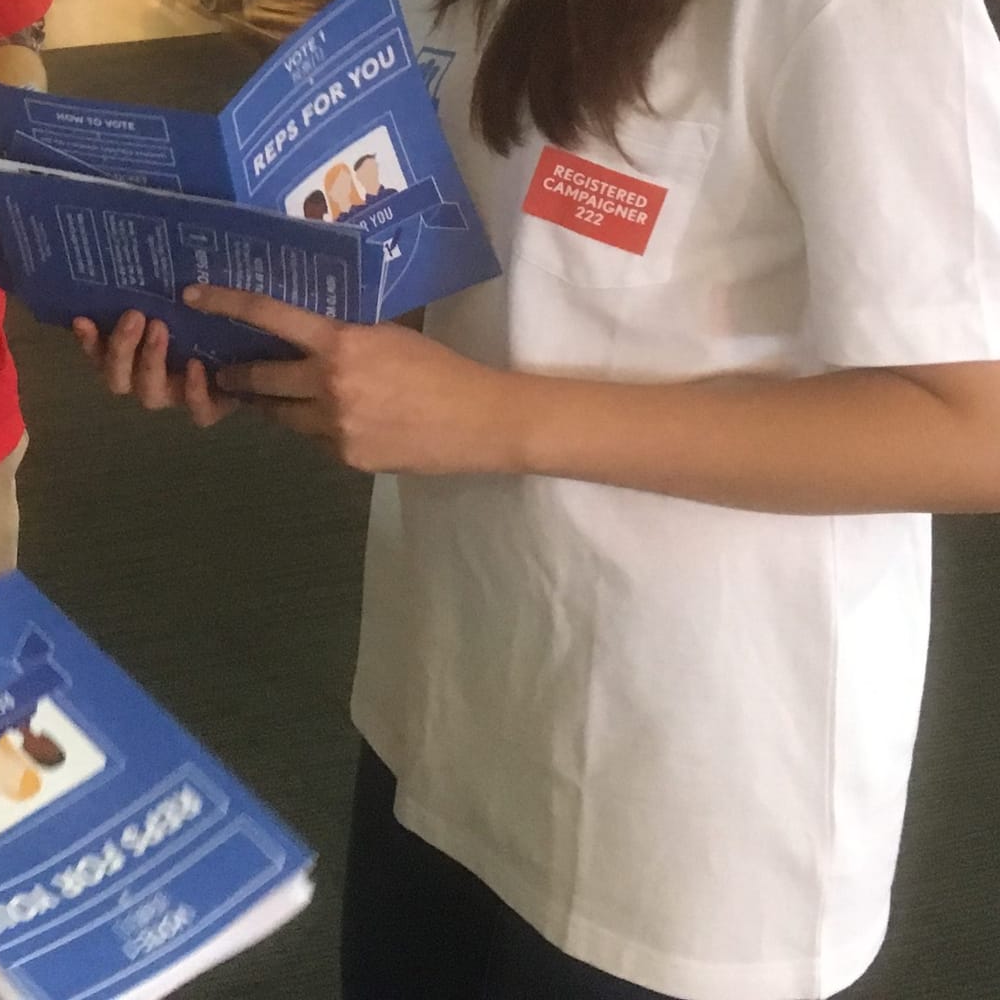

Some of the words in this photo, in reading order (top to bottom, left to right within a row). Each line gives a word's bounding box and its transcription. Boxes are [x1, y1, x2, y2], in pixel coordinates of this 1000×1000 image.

[284, 36, 316, 73] VOTE
[56, 112, 84, 125] HOW
[87, 116, 102, 127] TO
[104, 119, 136, 132] VOTE
[253, 119, 299, 176] REPS
[301, 81, 347, 127] FOR
[348, 45, 396, 89] YOU
[543, 177, 649, 225] CAMPAIGNER
[553, 165, 648, 209] REGISTERED
[369, 206, 394, 228] YOU
[574, 206, 604, 226] 222
